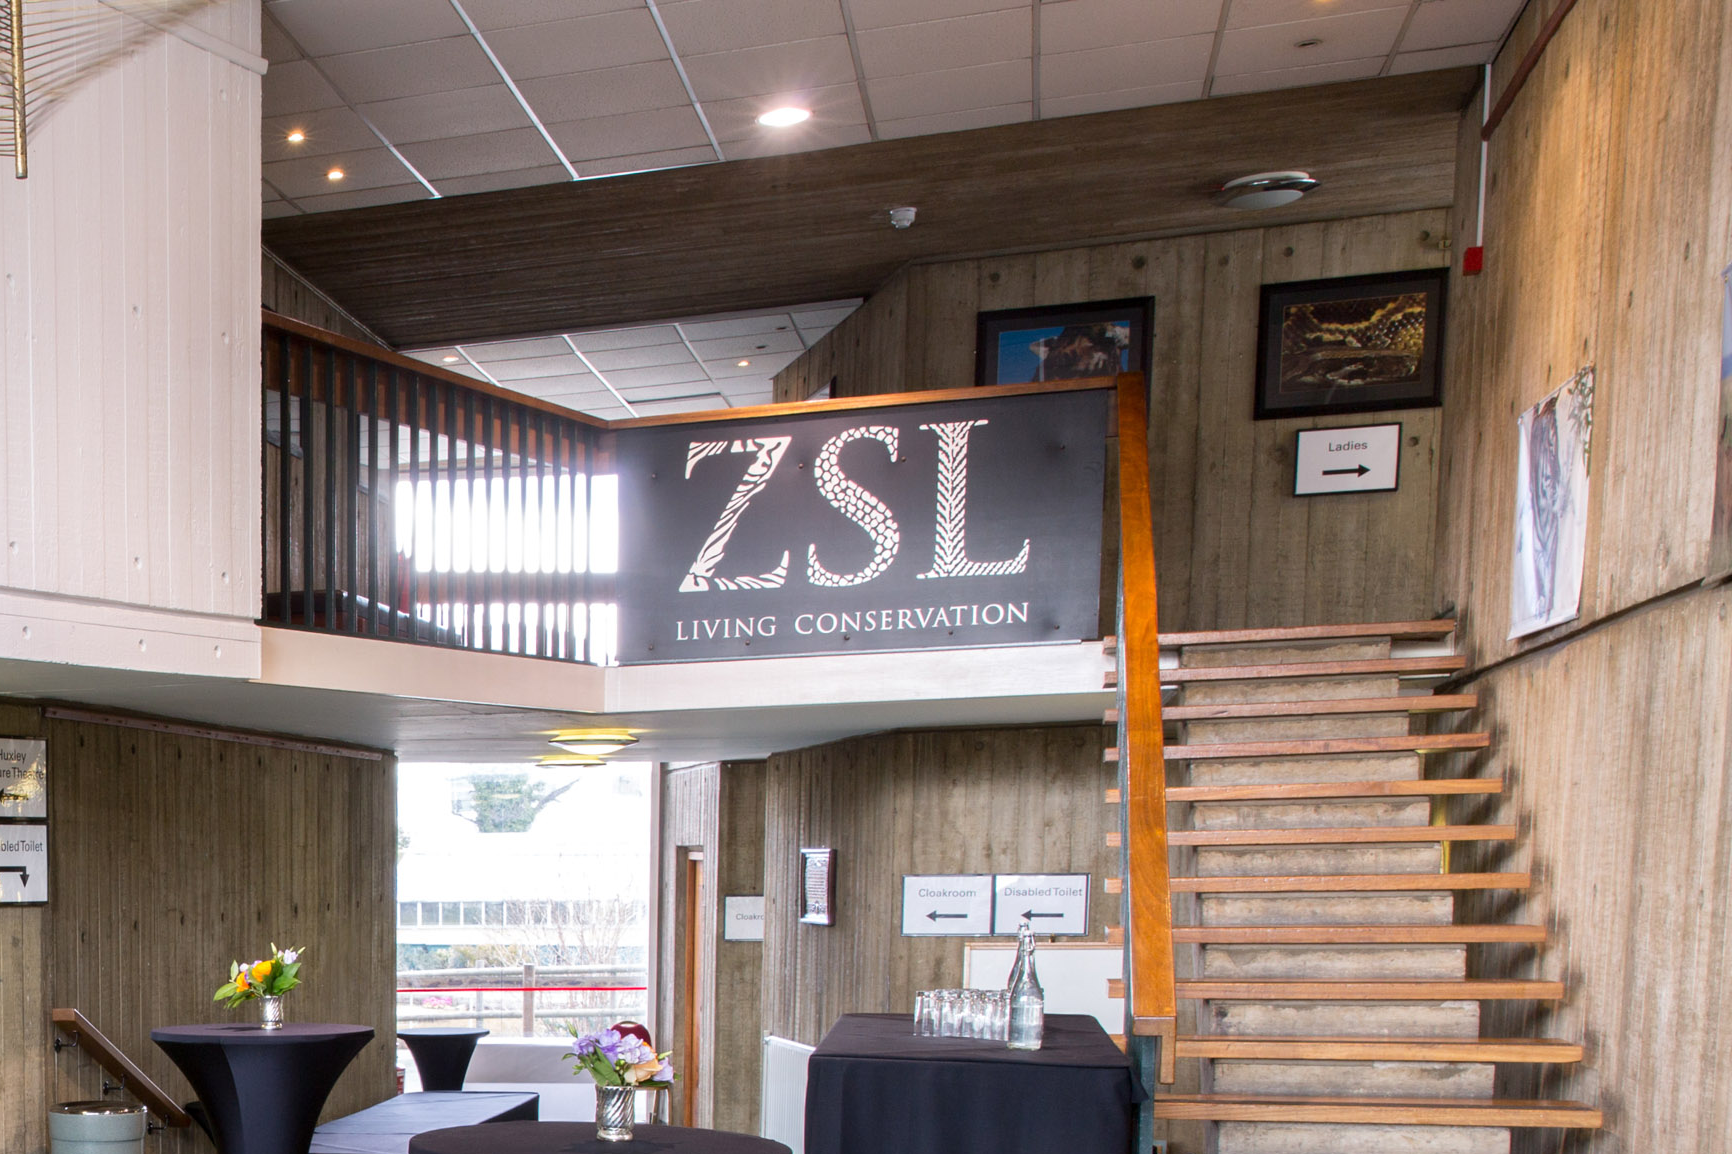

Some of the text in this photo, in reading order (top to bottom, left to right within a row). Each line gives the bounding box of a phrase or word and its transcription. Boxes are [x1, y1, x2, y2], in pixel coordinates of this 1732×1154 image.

[1328, 441, 1368, 452] Ladies
[678, 419, 1030, 592] ZSL
[676, 602, 1030, 641] LIVING CONSERVATION
[20, 840, 43, 852] Toilet
[918, 888, 977, 898] Cloakroom
[1004, 887, 1083, 897] Disabled Toilet
[735, 912, 765, 921] Cloakro
